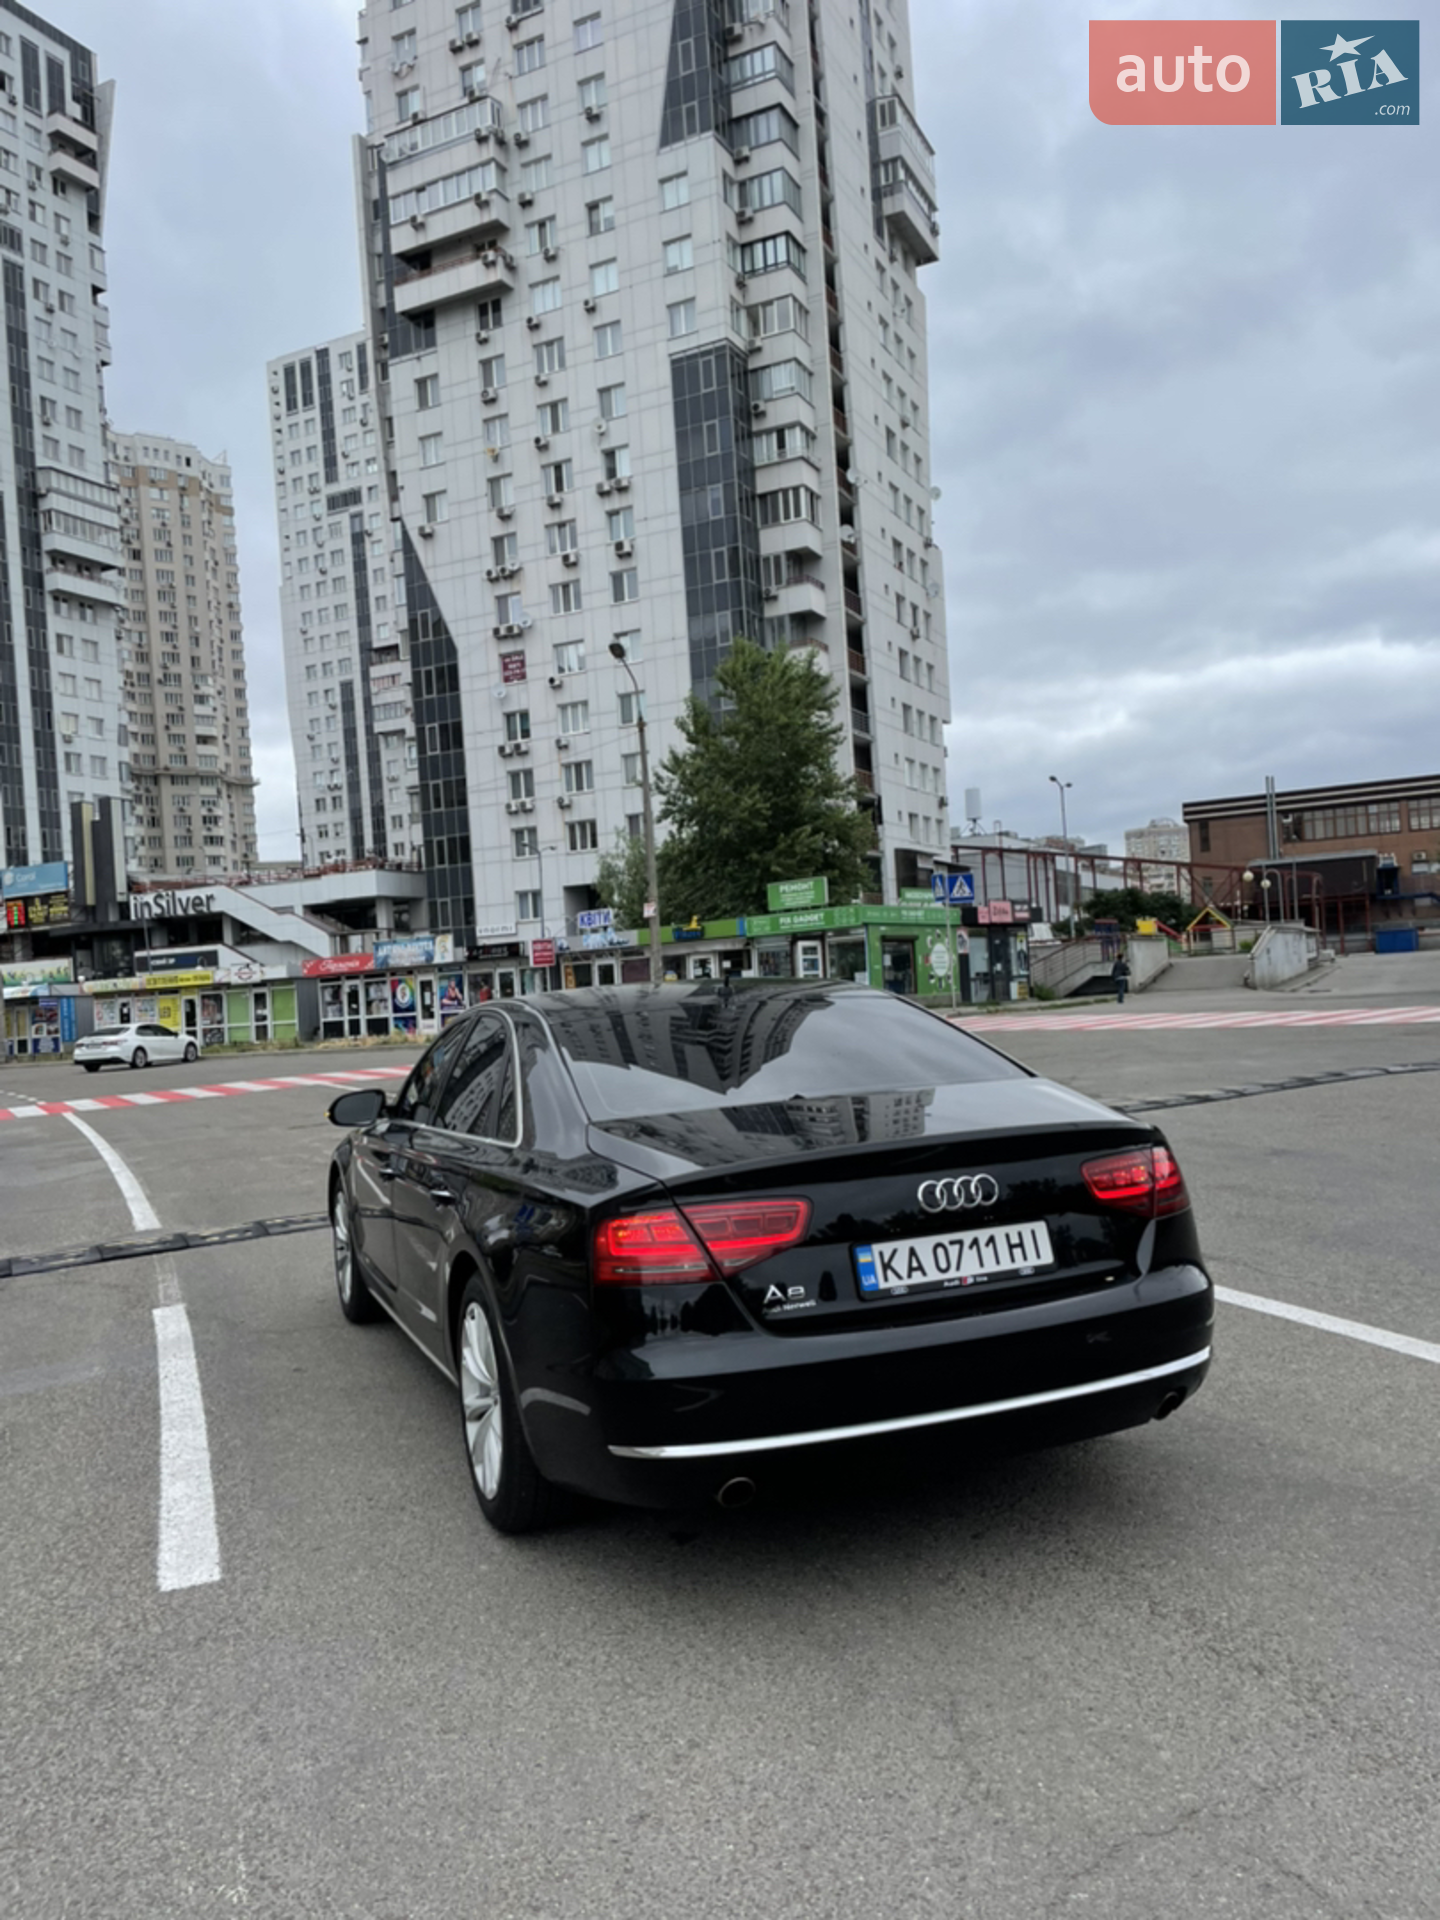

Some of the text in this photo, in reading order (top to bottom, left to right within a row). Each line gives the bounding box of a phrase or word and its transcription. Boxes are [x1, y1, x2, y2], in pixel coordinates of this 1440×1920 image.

[779, 881, 815, 893] РЕМОНТ
[133, 891, 215, 919] inSilver
[579, 909, 612, 928] КВІТИ
[861, 1274, 877, 1286] UA
[763, 1284, 805, 1304] A8
